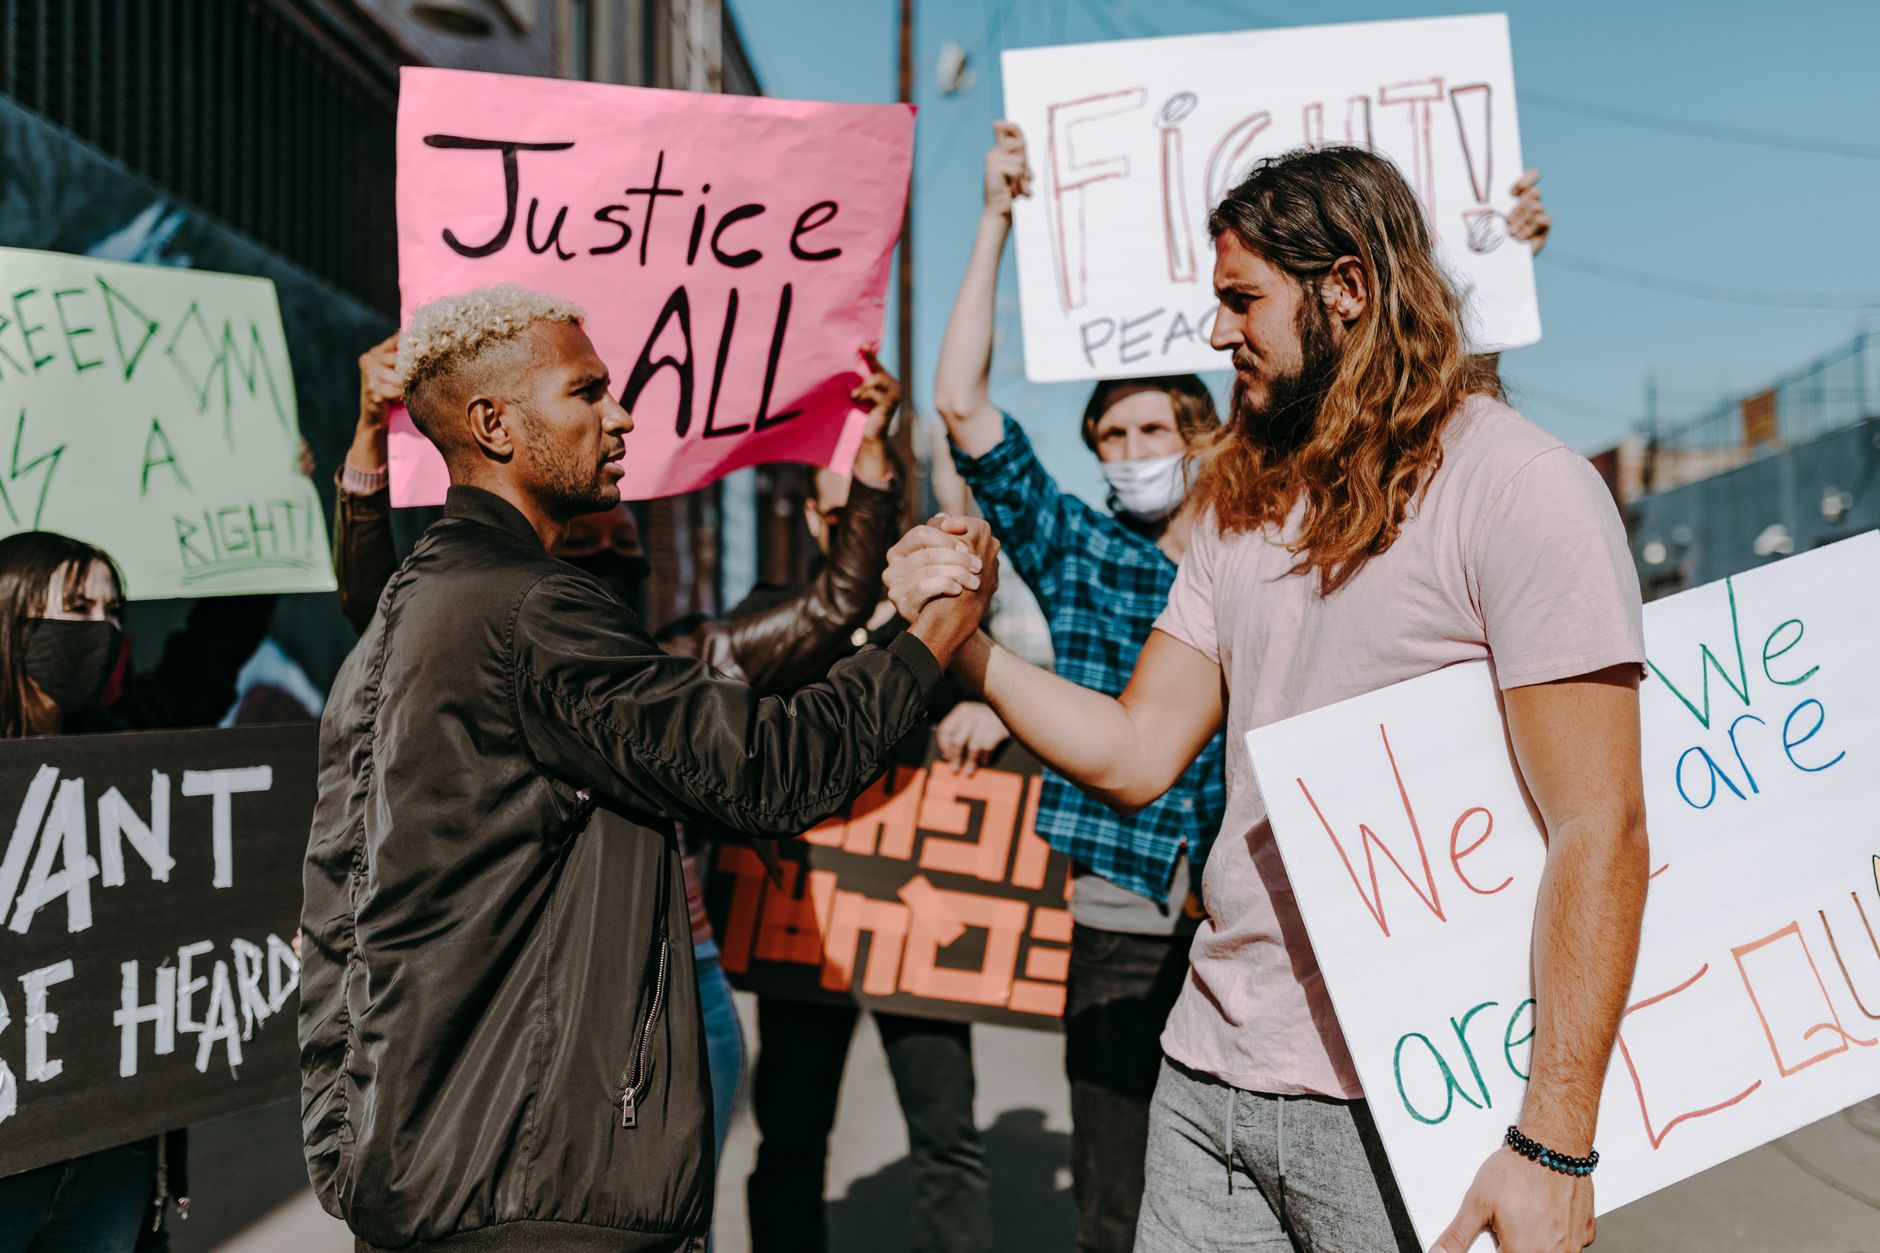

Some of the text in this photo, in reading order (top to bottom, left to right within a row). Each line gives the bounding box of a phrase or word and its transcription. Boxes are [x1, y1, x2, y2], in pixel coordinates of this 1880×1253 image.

[423, 134, 843, 268] Justice
[619, 282, 803, 438] ALL
[1080, 304, 1219, 367] PEAC
[140, 417, 192, 496] A
[174, 500, 315, 569] RIGHT!
[1646, 577, 1820, 729] We
[1675, 698, 1846, 809] are
[1296, 723, 1514, 937] We
[114, 934, 300, 1081] HEARD
